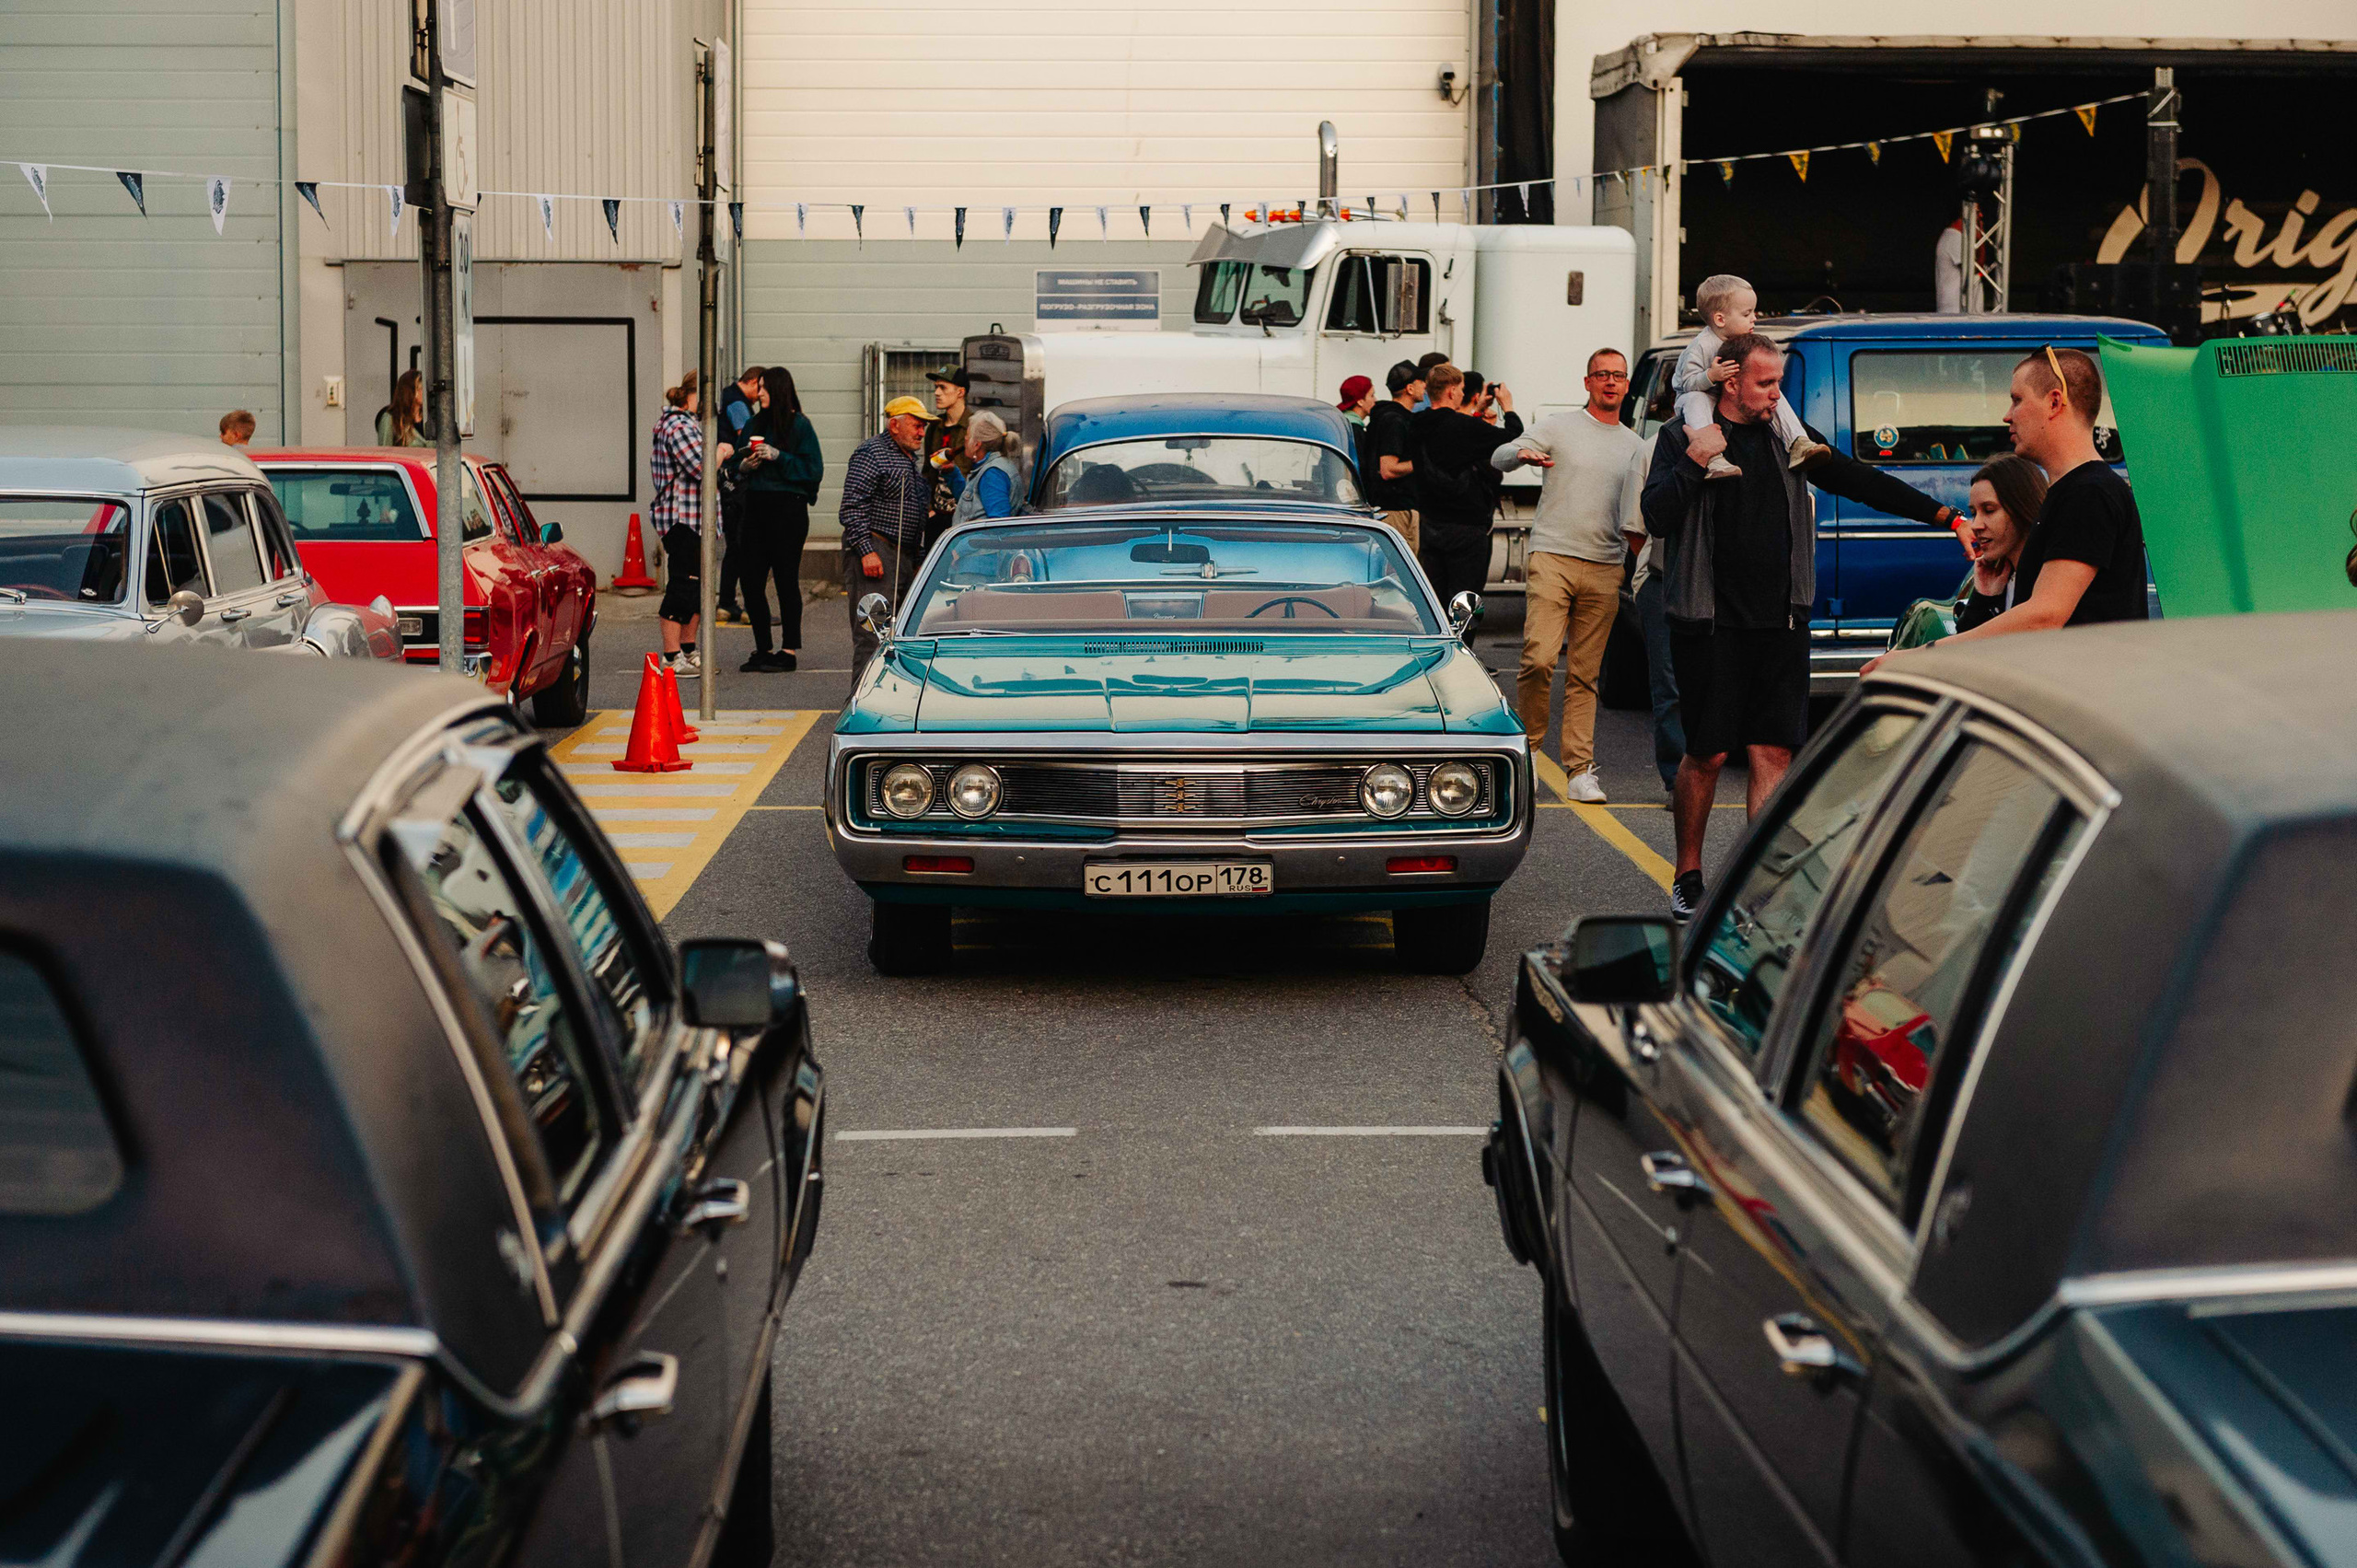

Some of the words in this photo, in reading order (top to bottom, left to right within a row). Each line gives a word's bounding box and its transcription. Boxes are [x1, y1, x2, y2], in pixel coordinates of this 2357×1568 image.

[459, 232, 469, 273] 20
[1299, 794, 1342, 808] Chrysler
[1219, 866, 1262, 885] 178
